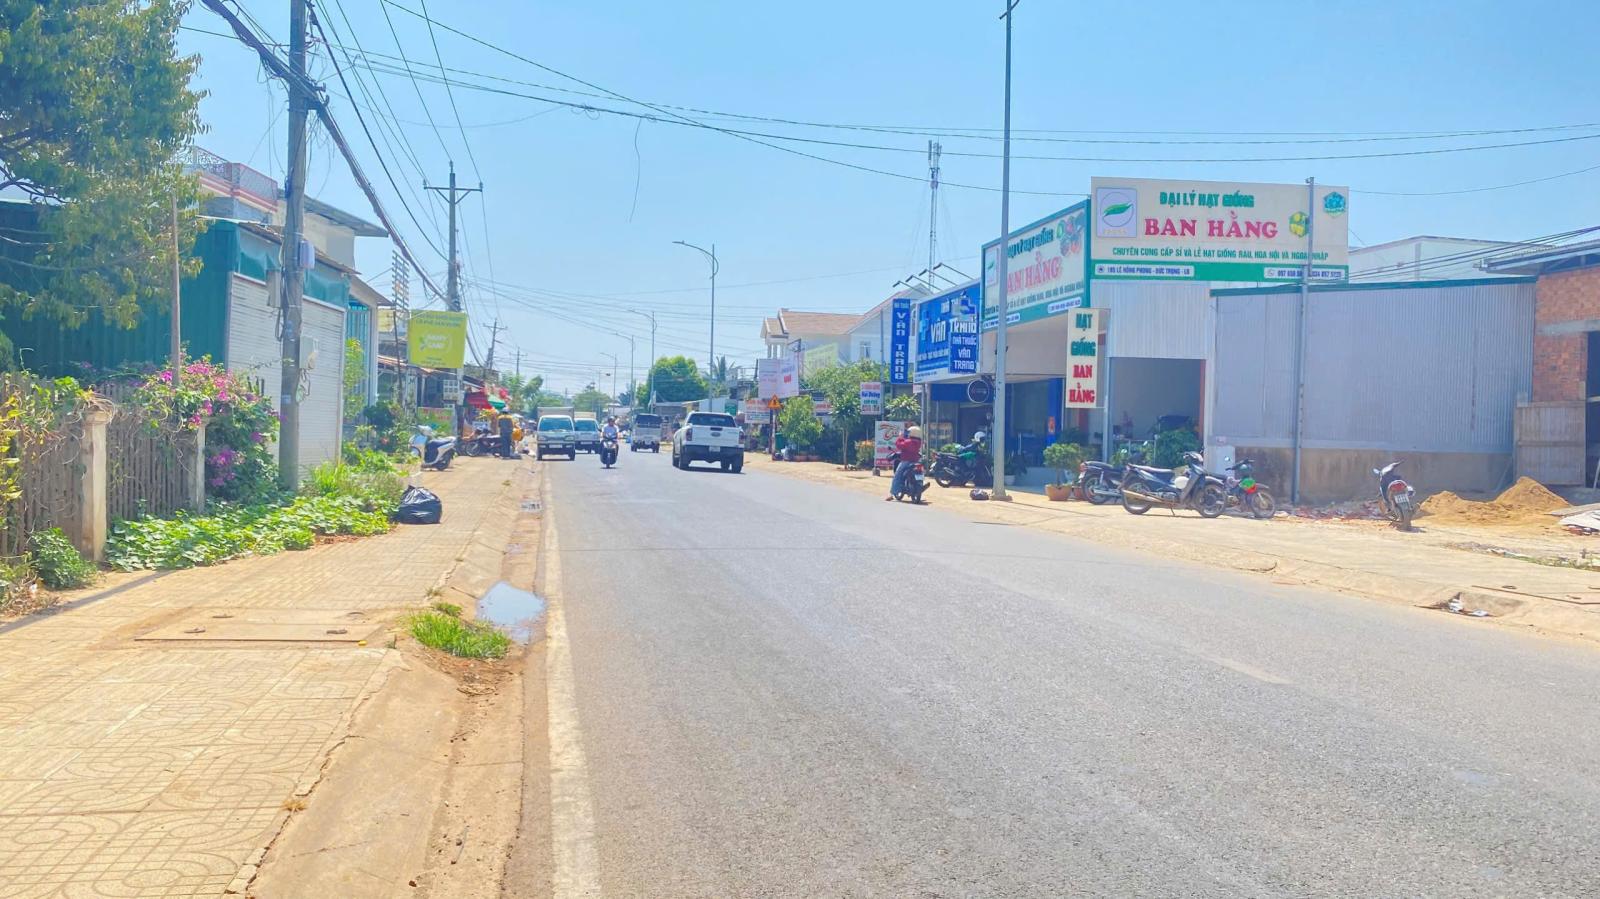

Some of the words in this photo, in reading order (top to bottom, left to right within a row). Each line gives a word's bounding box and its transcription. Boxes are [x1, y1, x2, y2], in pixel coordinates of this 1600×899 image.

[1160, 191, 1180, 208] ĐẠI
[1182, 189, 1196, 206] LÝ
[1198, 193, 1219, 208] HẠT
[1222, 190, 1255, 208] GIỐNG
[1144, 217, 1197, 237] BAN
[1207, 209, 1279, 239] HẰNG
[1140, 247, 1159, 257] CUNG
[1160, 246, 1174, 257] CẤP
[1254, 250, 1267, 260] HOA
[1007, 269, 1022, 295] AN
[1075, 313, 1093, 332] HẠT
[894, 343, 906, 380] TRANG
[958, 346, 971, 359] VÂN
[953, 359, 975, 370] TRANG
[1073, 364, 1093, 378] BAN
[1068, 381, 1095, 403] HẰNG
